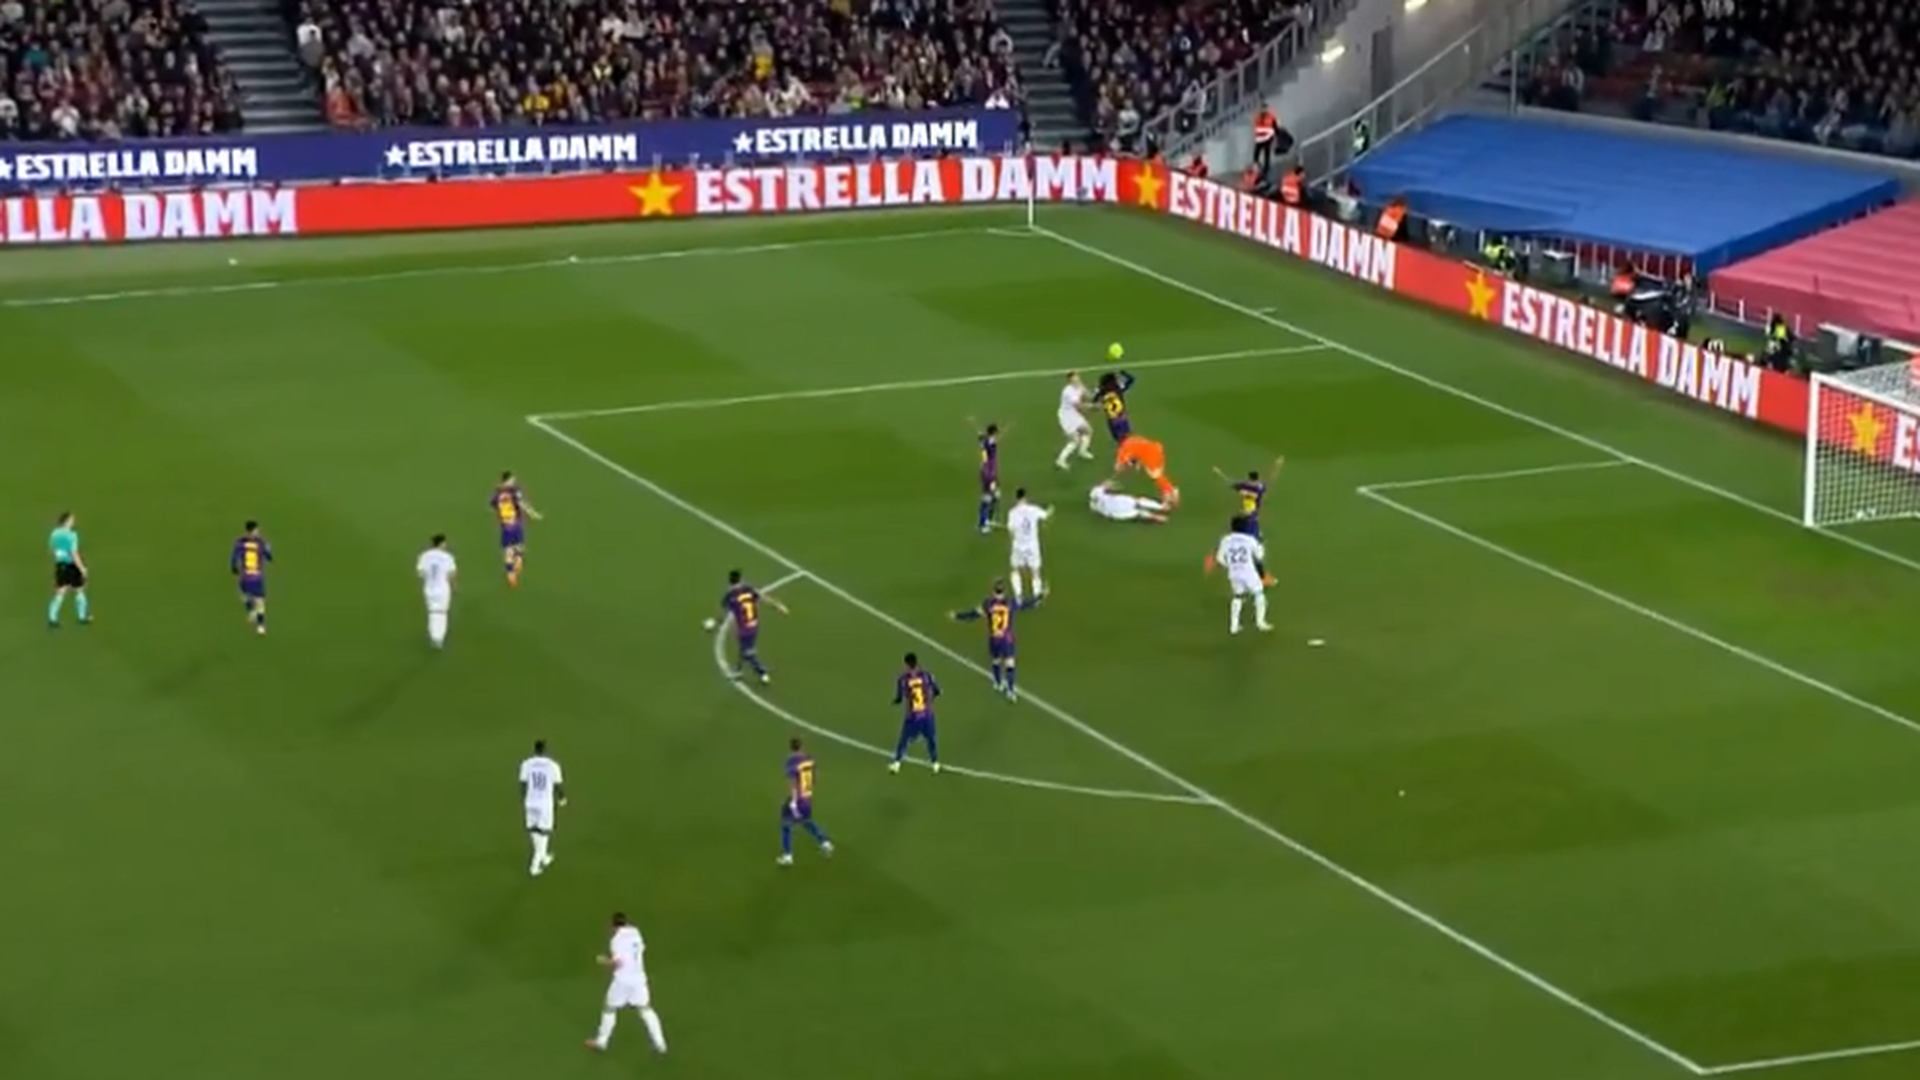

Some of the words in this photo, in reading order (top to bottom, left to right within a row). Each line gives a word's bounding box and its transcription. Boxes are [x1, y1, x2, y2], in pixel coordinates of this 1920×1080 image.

[408, 137, 544, 166] ESTRELLA
[549, 134, 637, 162] DAMM
[756, 124, 887, 152] ESTRELLA
[892, 120, 978, 148] DAMM
[16, 150, 159, 179] ESTRELLA
[164, 147, 257, 176] DAMM
[695, 161, 945, 213] ESTRELLA
[962, 156, 1118, 202] DAMM
[0, 193, 107, 242] LLA
[122, 189, 297, 239] DAMM
[1168, 172, 1301, 255] ESTRELLA
[1309, 211, 1396, 290] DAMM
[1502, 280, 1648, 378] ESTRELLA
[1655, 333, 1762, 419] DAMM
[1229, 545, 1248, 564] 22
[911, 687, 924, 709] 3
